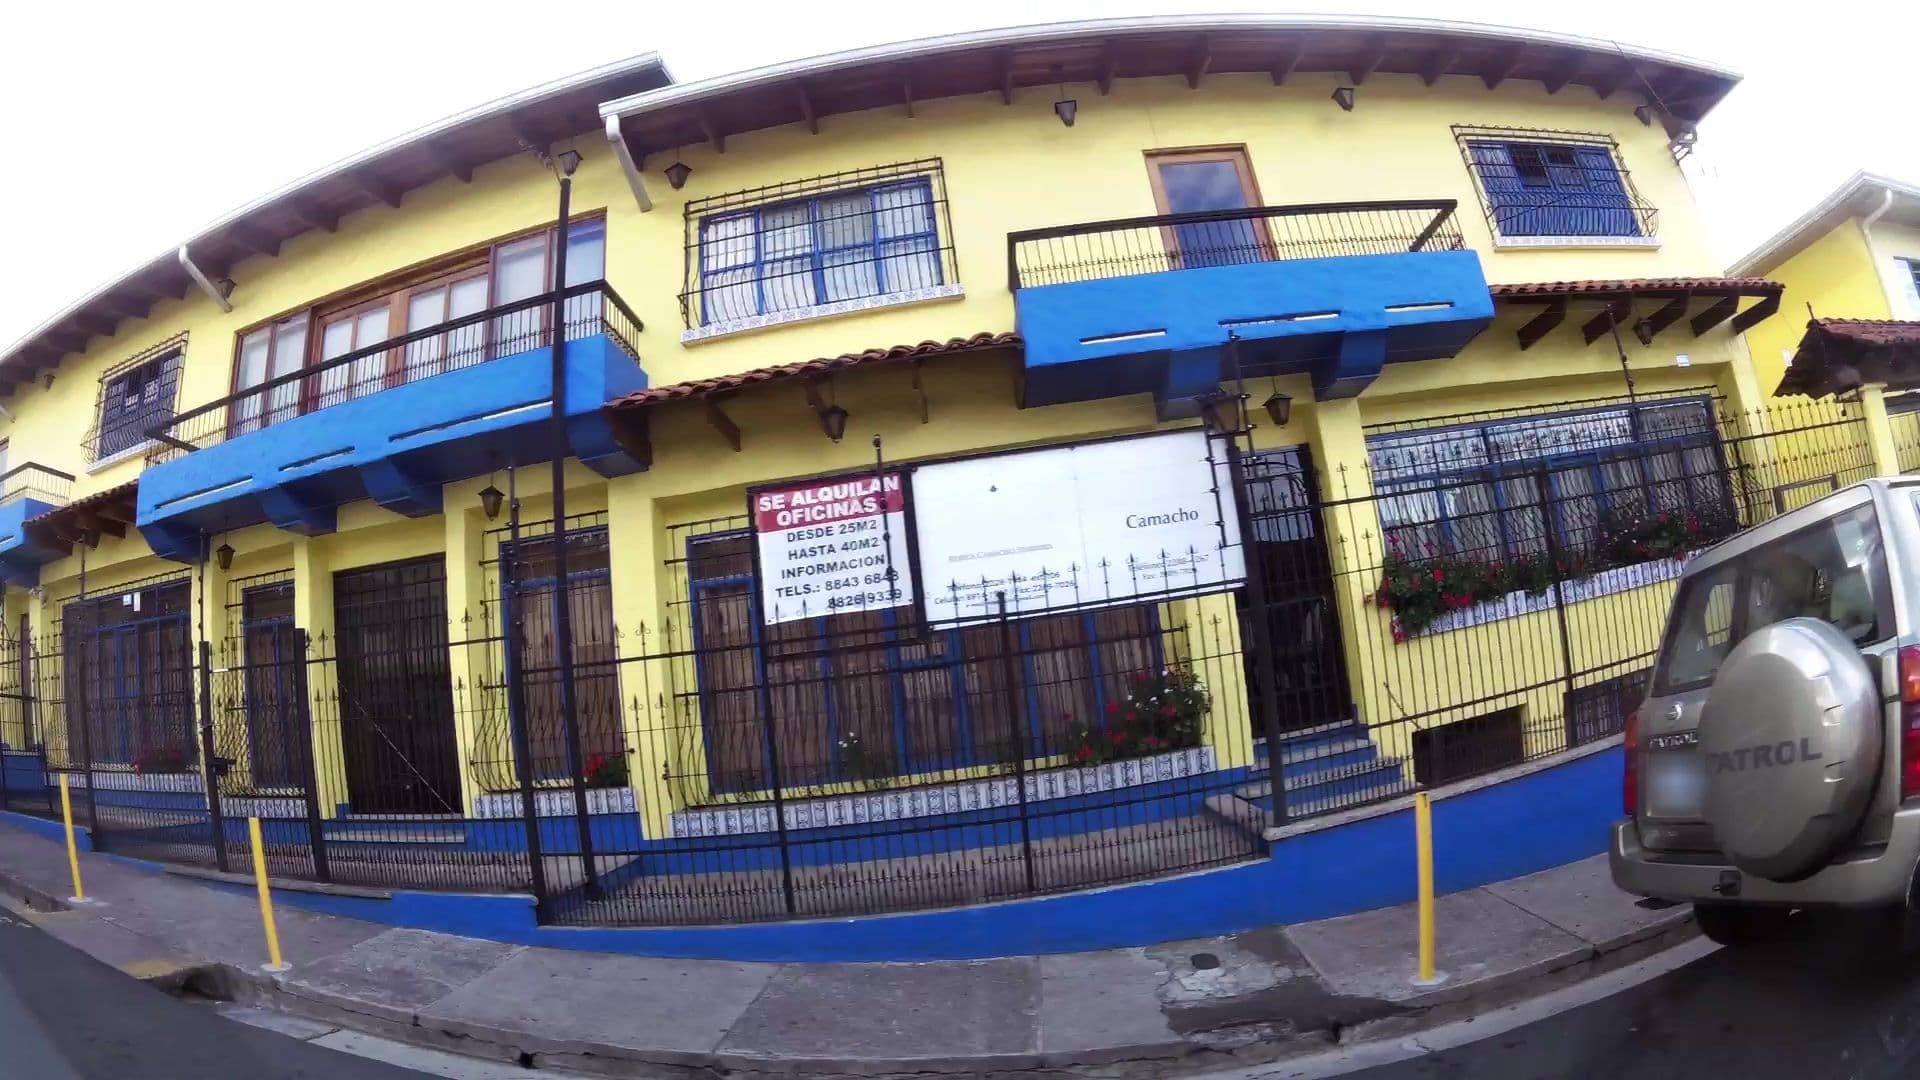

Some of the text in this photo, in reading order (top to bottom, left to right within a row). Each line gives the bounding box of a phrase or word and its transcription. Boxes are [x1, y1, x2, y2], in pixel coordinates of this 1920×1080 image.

[759, 475, 899, 512] SE ALQUILAN
[776, 496, 878, 526] OFICINAS
[1126, 507, 1199, 529] Camacho
[787, 519, 877, 543] DESDE 25M2
[788, 537, 880, 561] HASTA 40M2
[781, 554, 885, 579] INFORMACION
[776, 584, 821, 599] TELS.:
[825, 576, 860, 591] 8843
